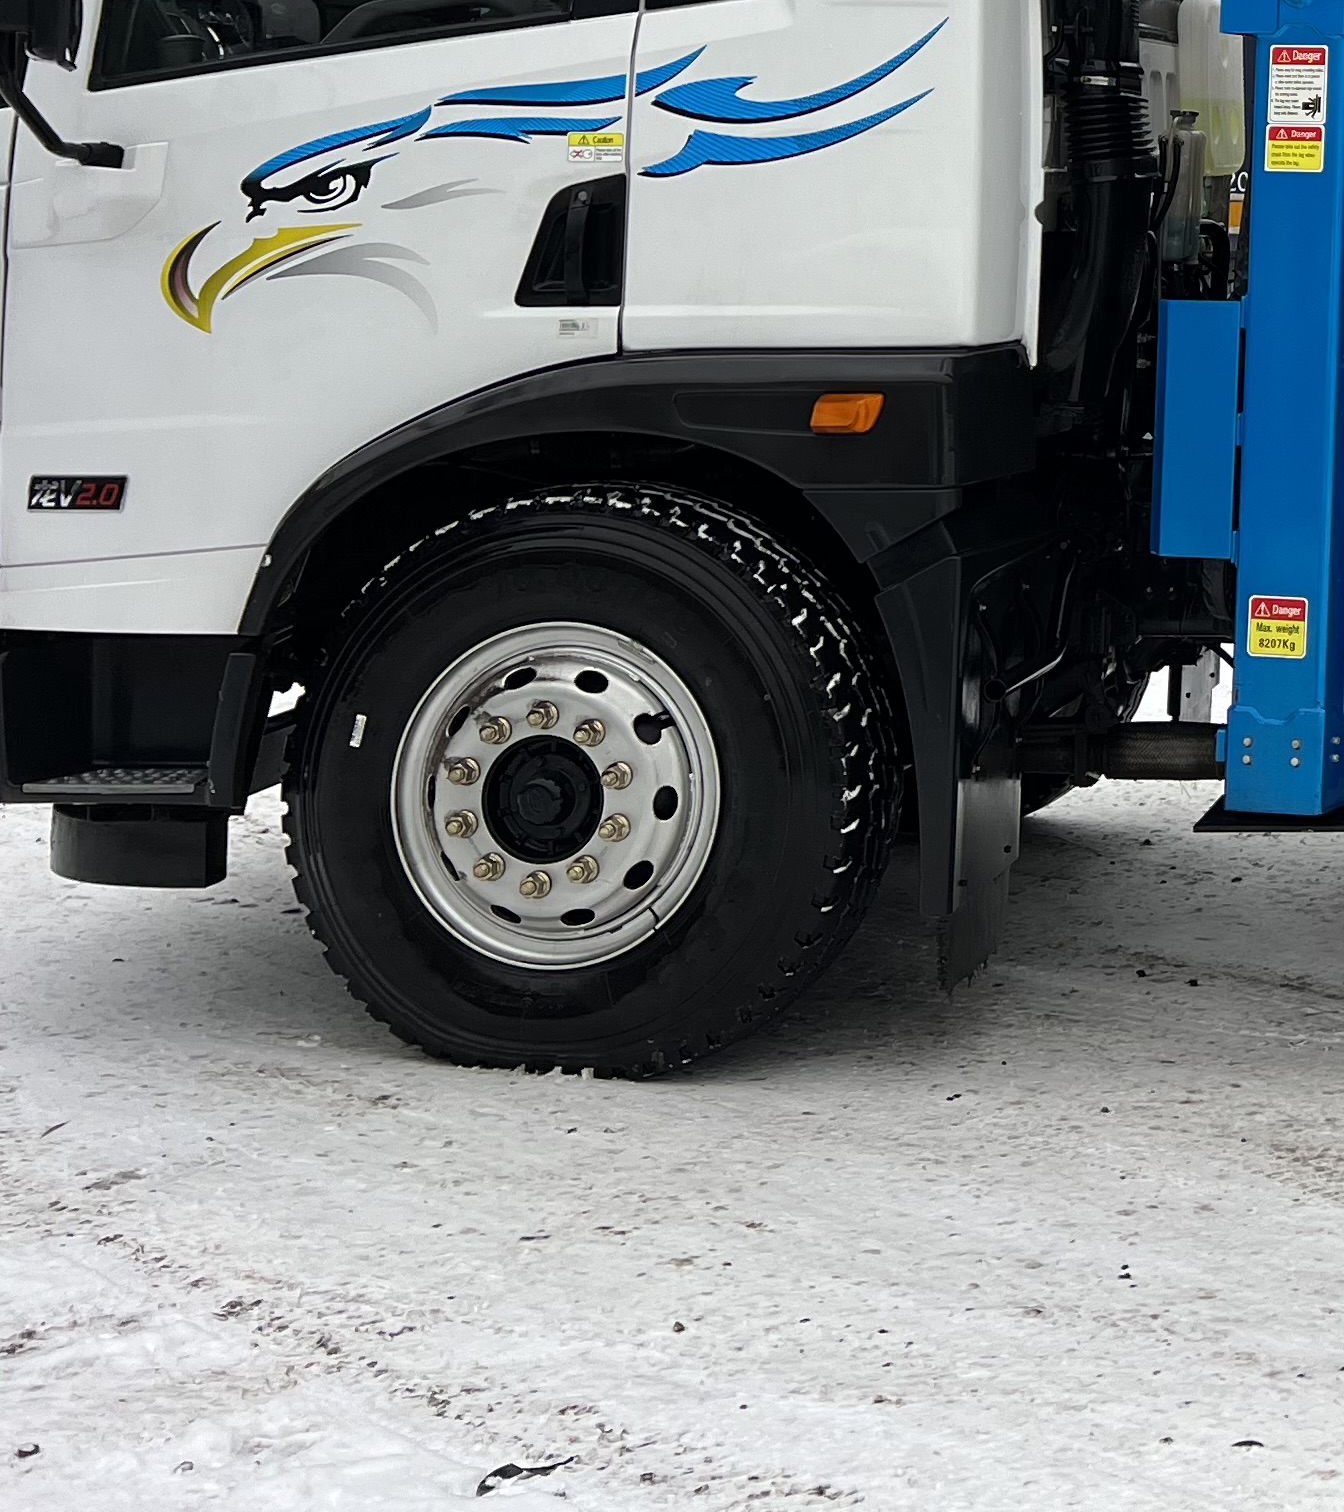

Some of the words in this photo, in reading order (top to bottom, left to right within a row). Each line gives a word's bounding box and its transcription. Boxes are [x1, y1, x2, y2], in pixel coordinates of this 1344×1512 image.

[1293, 50, 1322, 63] Danger
[1291, 130, 1316, 139] Danger
[1272, 604, 1302, 618] Danger
